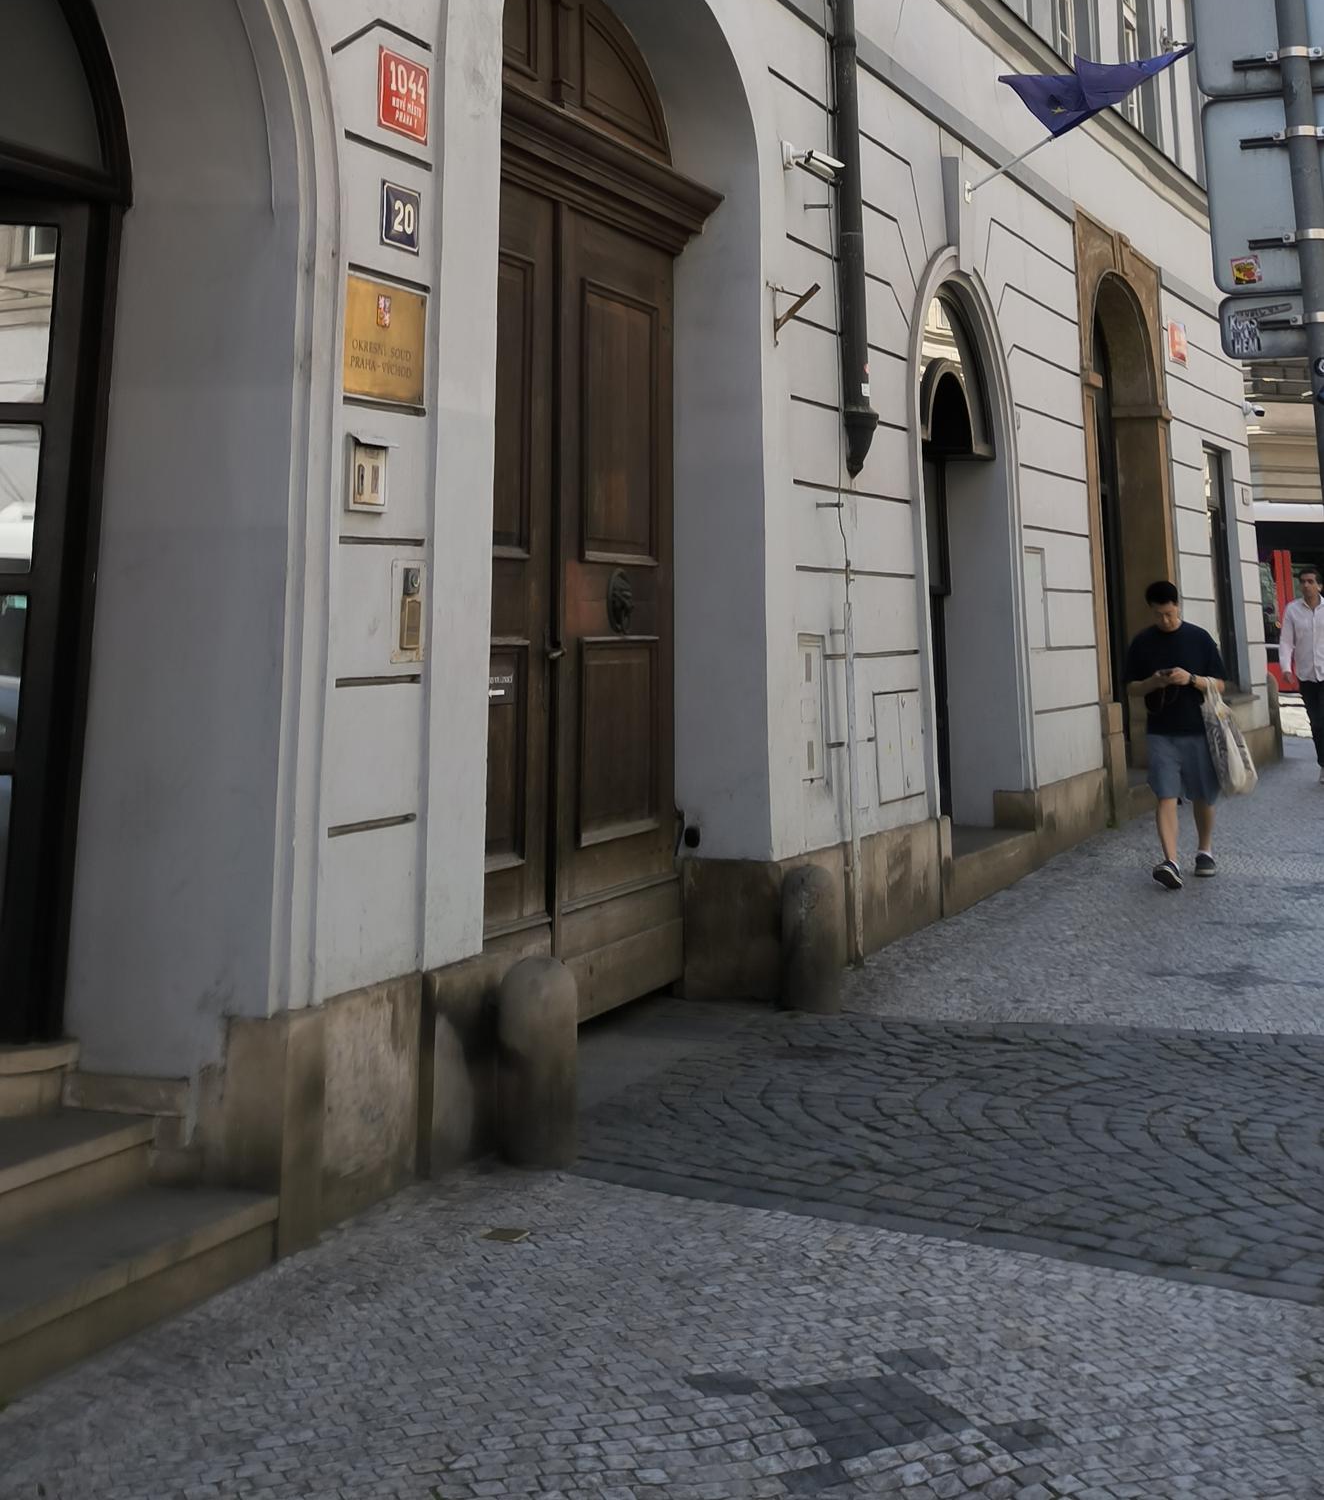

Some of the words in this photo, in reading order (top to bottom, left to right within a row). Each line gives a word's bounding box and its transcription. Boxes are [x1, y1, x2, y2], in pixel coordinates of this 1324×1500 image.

[390, 60, 425, 105] 1044
[395, 109, 413, 127] PRAHA
[394, 200, 414, 235] 20
[390, 347, 412, 362] SOUD
